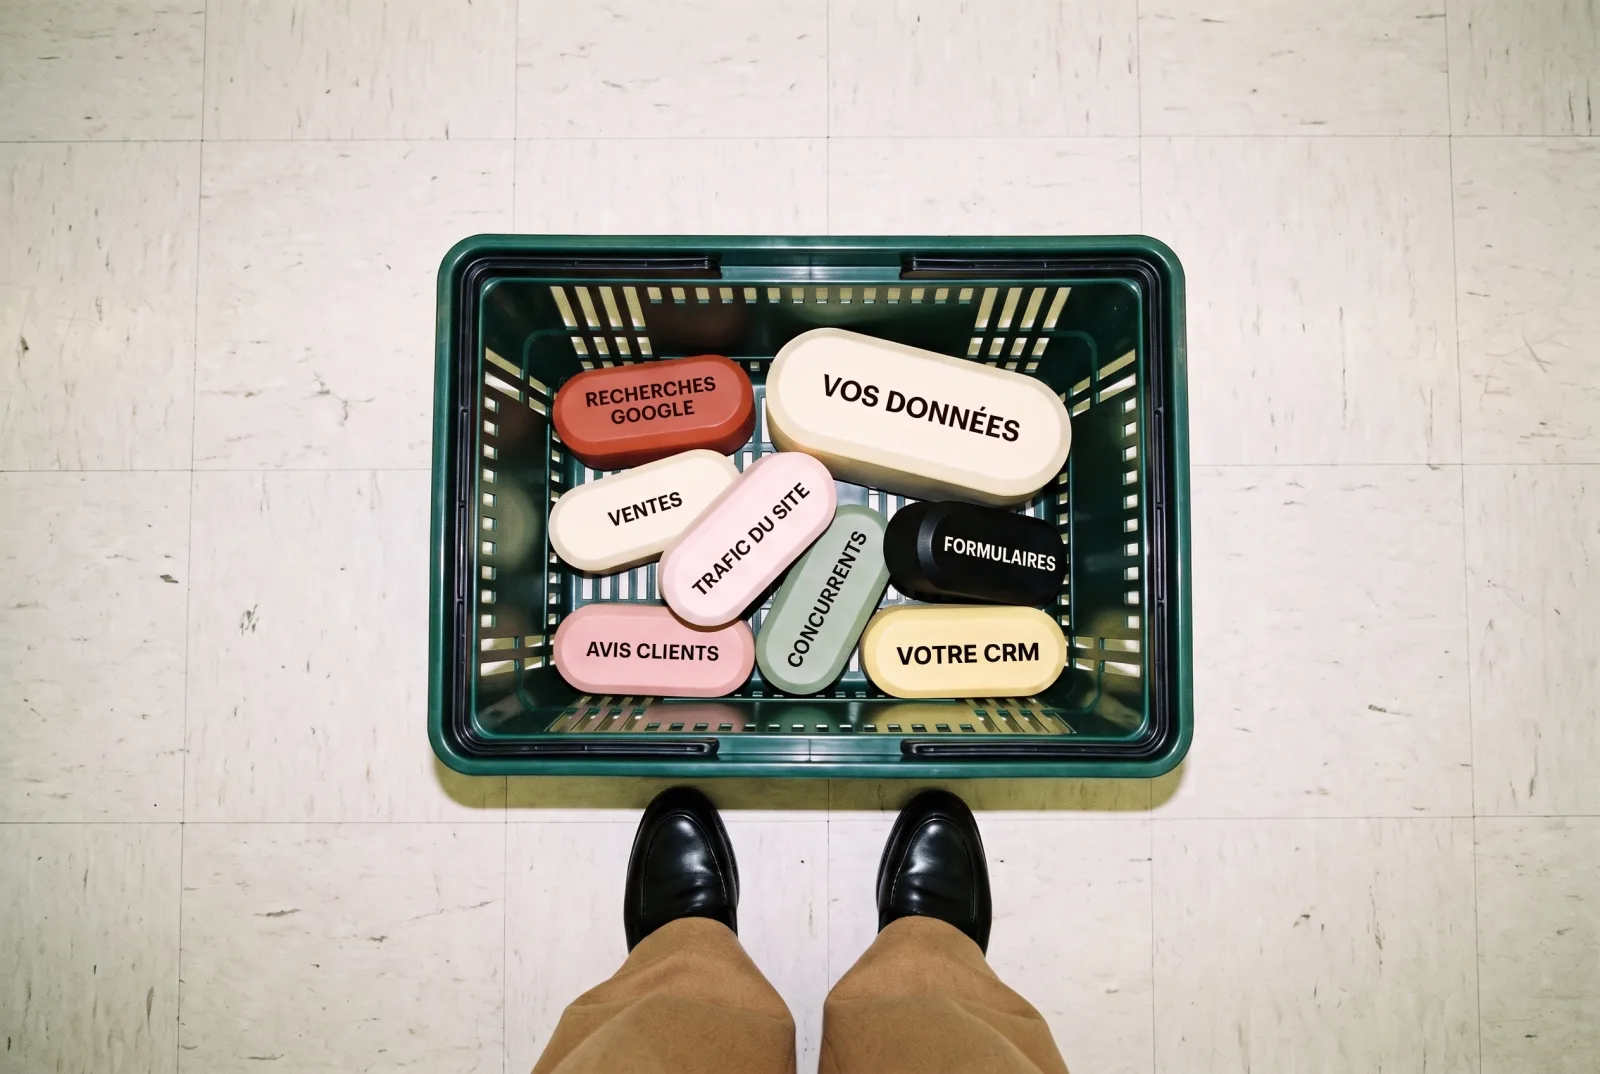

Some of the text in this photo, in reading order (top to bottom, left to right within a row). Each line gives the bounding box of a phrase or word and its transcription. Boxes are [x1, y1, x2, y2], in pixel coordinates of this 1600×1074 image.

[586, 377, 715, 407] RECHERCHES
[825, 374, 1019, 441] VOS DONNÉES
[611, 400, 694, 424] GOOGLE
[608, 492, 682, 526] VENTES
[692, 483, 810, 594] TRAFIC DU SITE
[945, 536, 1055, 571] FORMULAIRES
[788, 532, 866, 667] CONCURRENTS
[587, 642, 718, 661] AVIS CLIENTS
[897, 643, 1038, 665] VOTRE CRM
